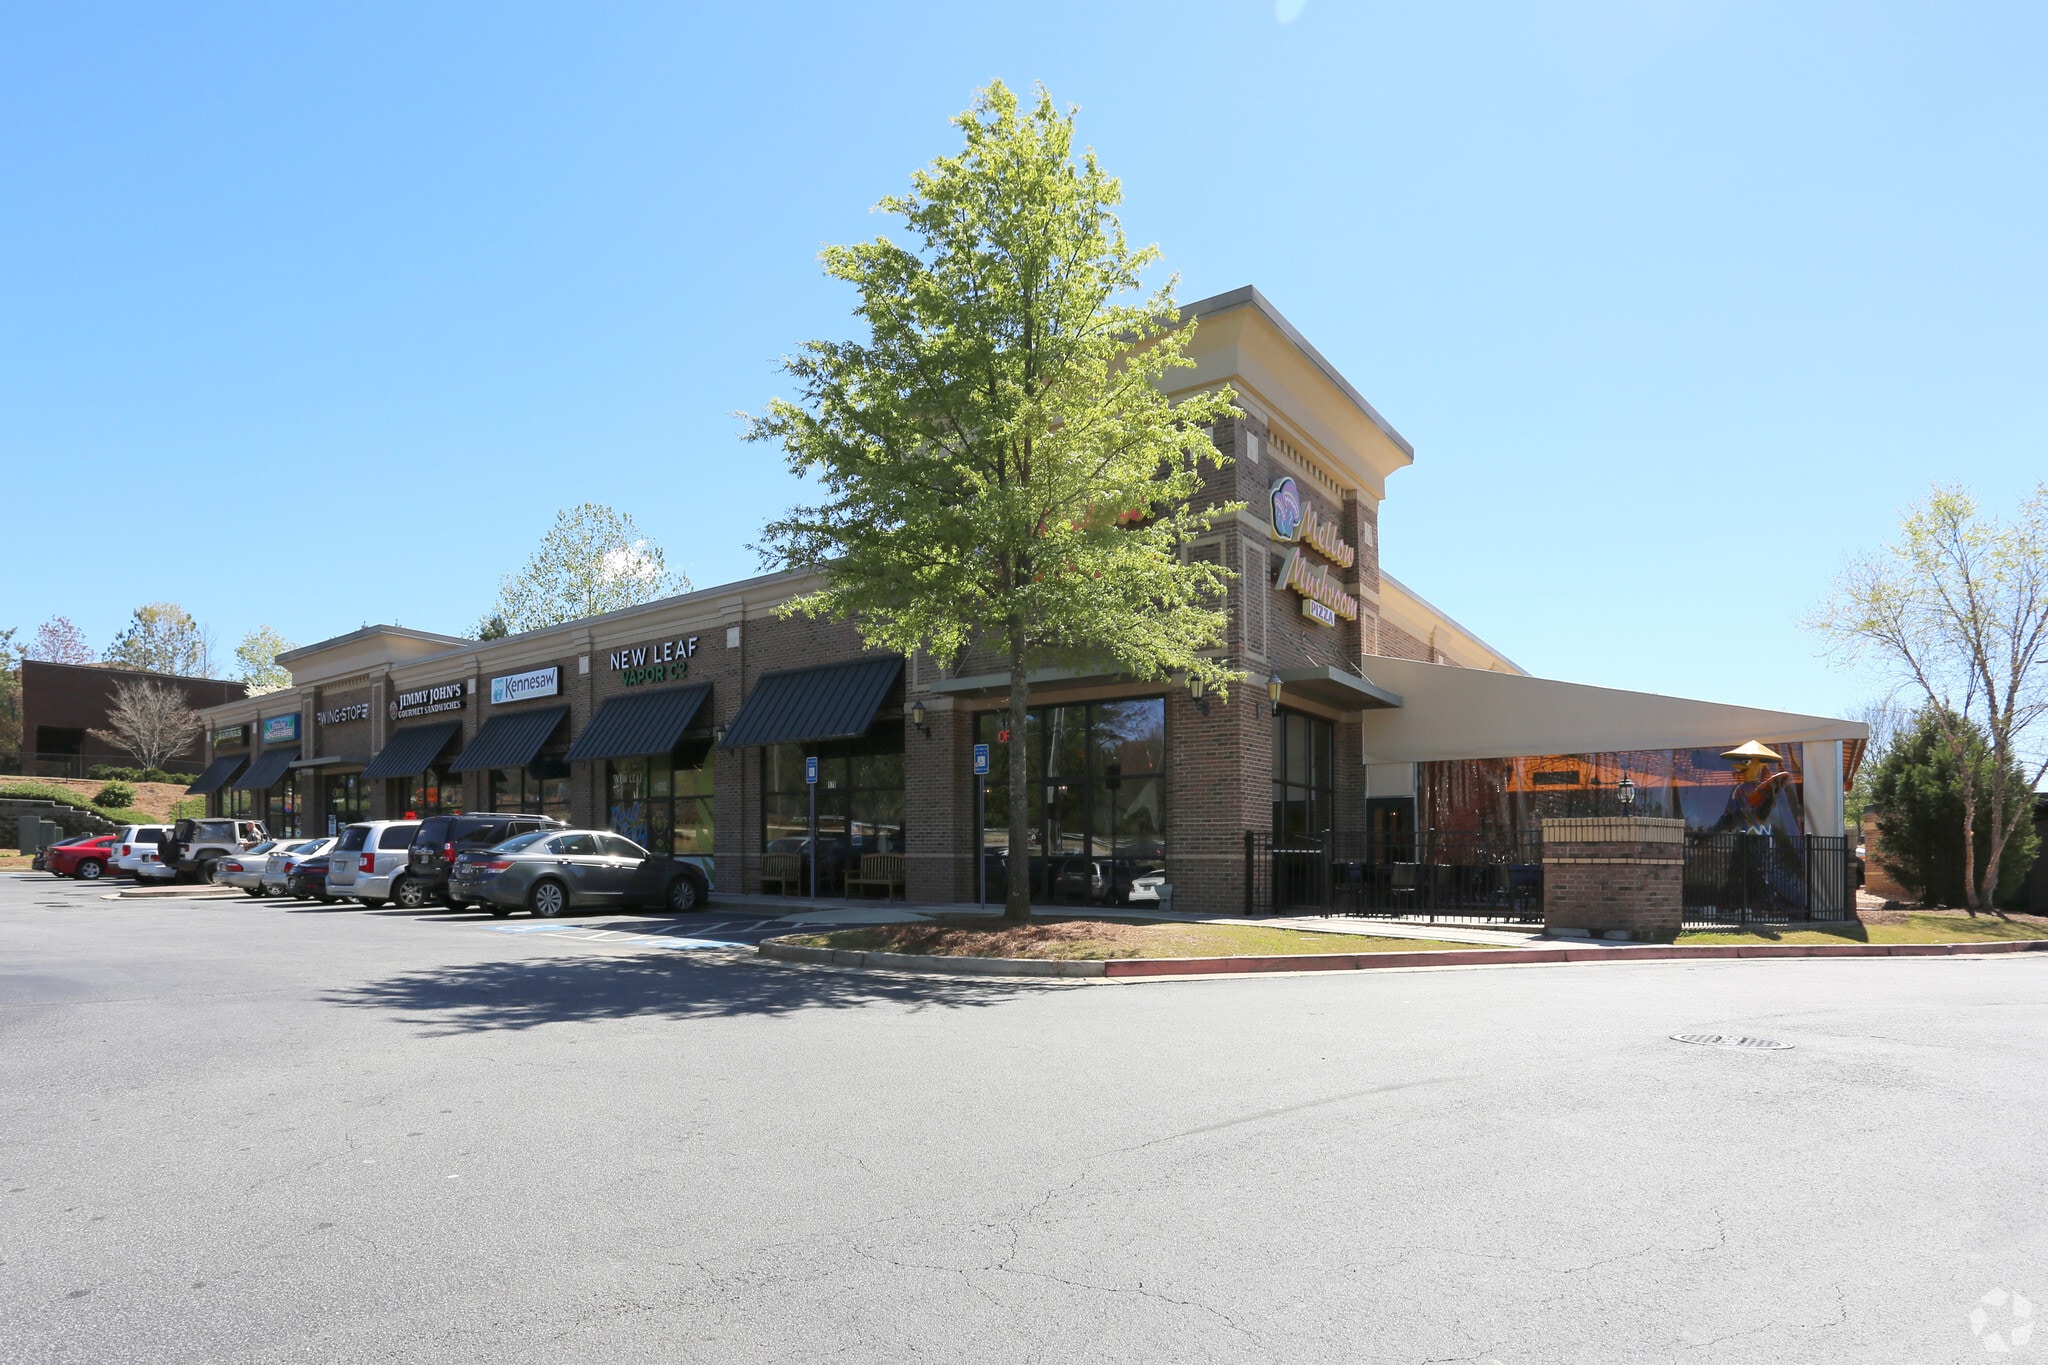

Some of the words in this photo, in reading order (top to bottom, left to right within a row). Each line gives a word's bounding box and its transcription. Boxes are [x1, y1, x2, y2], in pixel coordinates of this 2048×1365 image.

[1297, 501, 1355, 568] Mellow
[1281, 547, 1358, 620] Mushroom
[1310, 601, 1334, 625] PIZZA
[610, 646, 647, 671] NEW
[653, 636, 698, 664] LEAF
[505, 668, 556, 699] Kennesaw
[621, 664, 665, 687] VAPOR
[397, 706, 424, 719] GOURMET
[424, 700, 461, 715] SANDWICHES
[399, 689, 429, 711] JIMMY
[429, 683, 461, 705] JOHN'S
